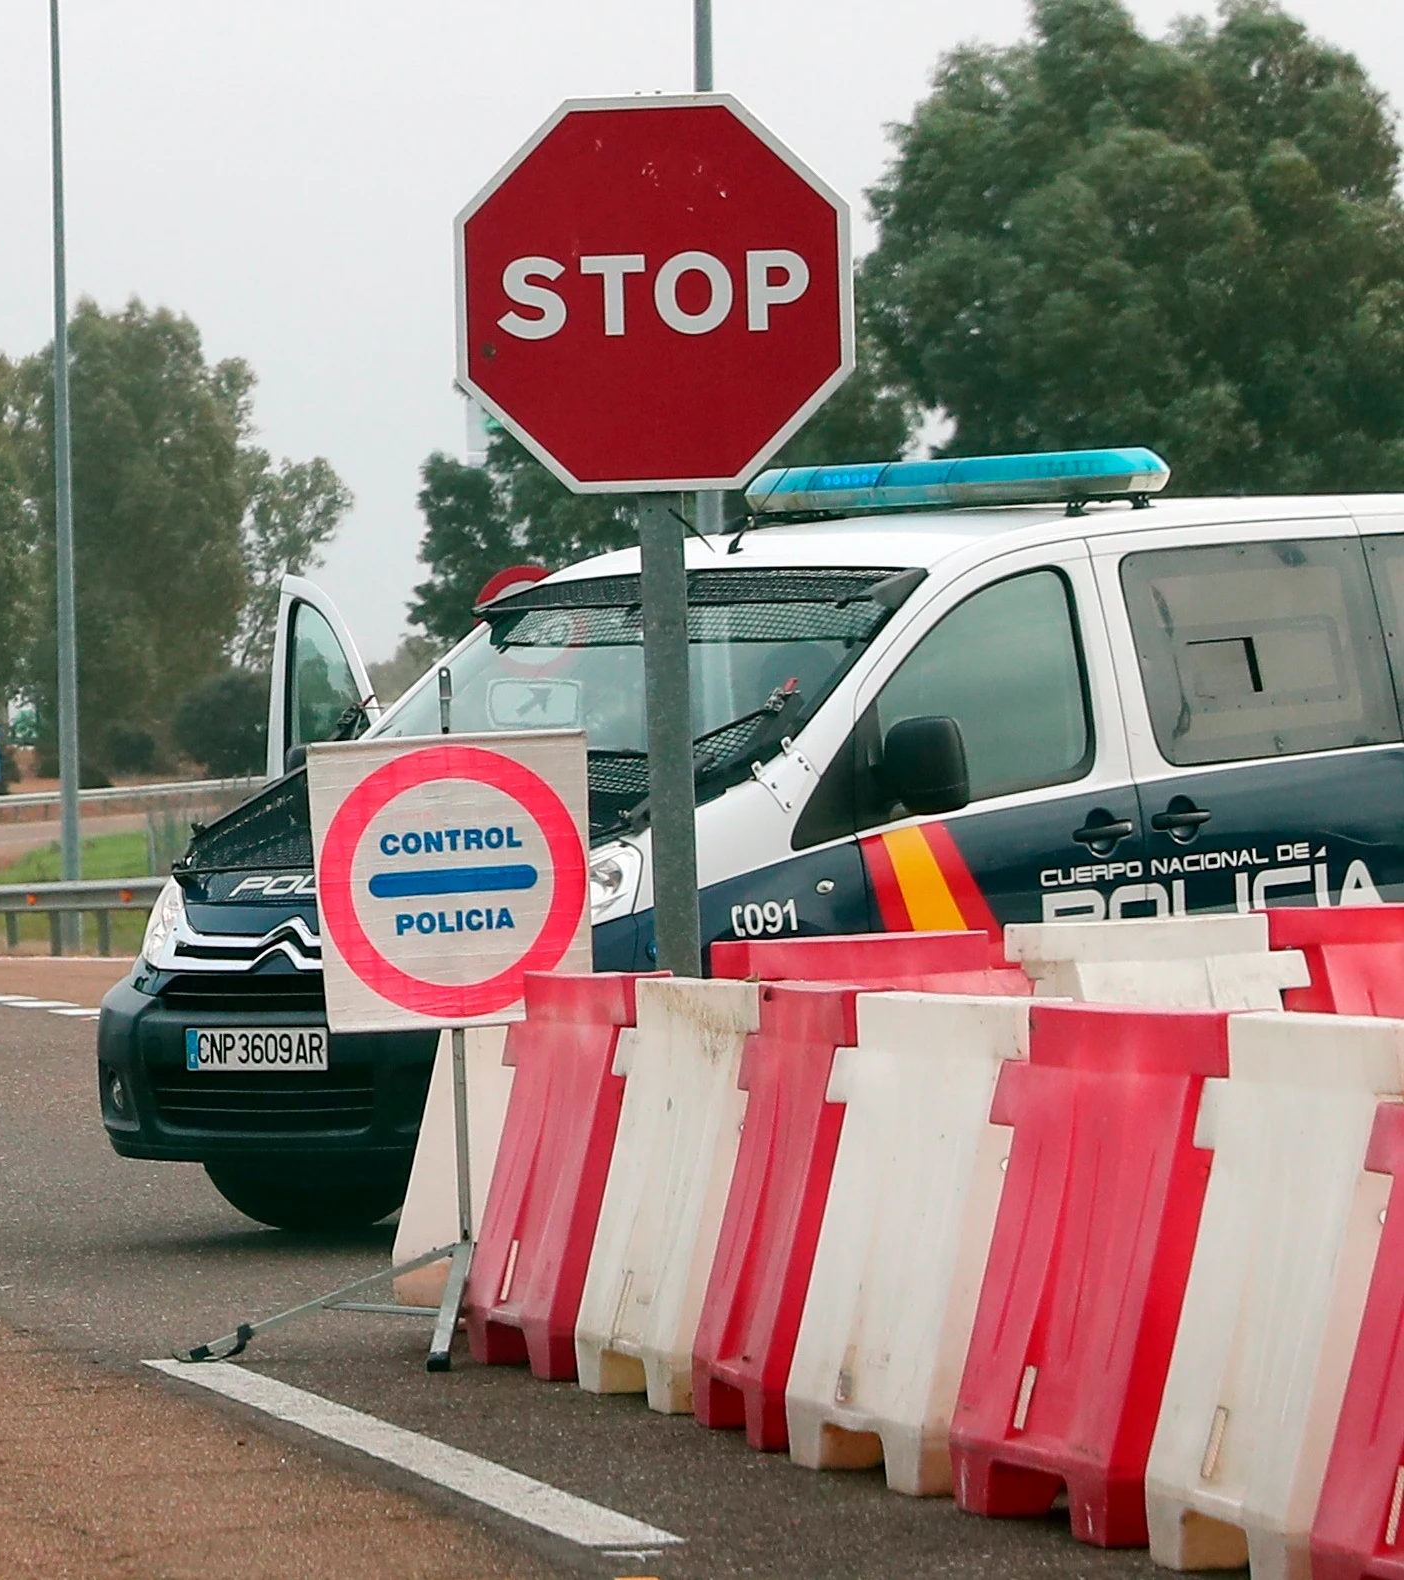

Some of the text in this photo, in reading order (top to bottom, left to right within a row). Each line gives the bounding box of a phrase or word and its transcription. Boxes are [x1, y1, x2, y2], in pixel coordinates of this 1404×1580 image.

[497, 249, 810, 340] STOP
[380, 826, 523, 856] CONTROL
[1040, 842, 1310, 887] CUERPO NACIONAL DE
[396, 907, 515, 936] POLICIA
[198, 1033, 323, 1065] CNP3609AR
